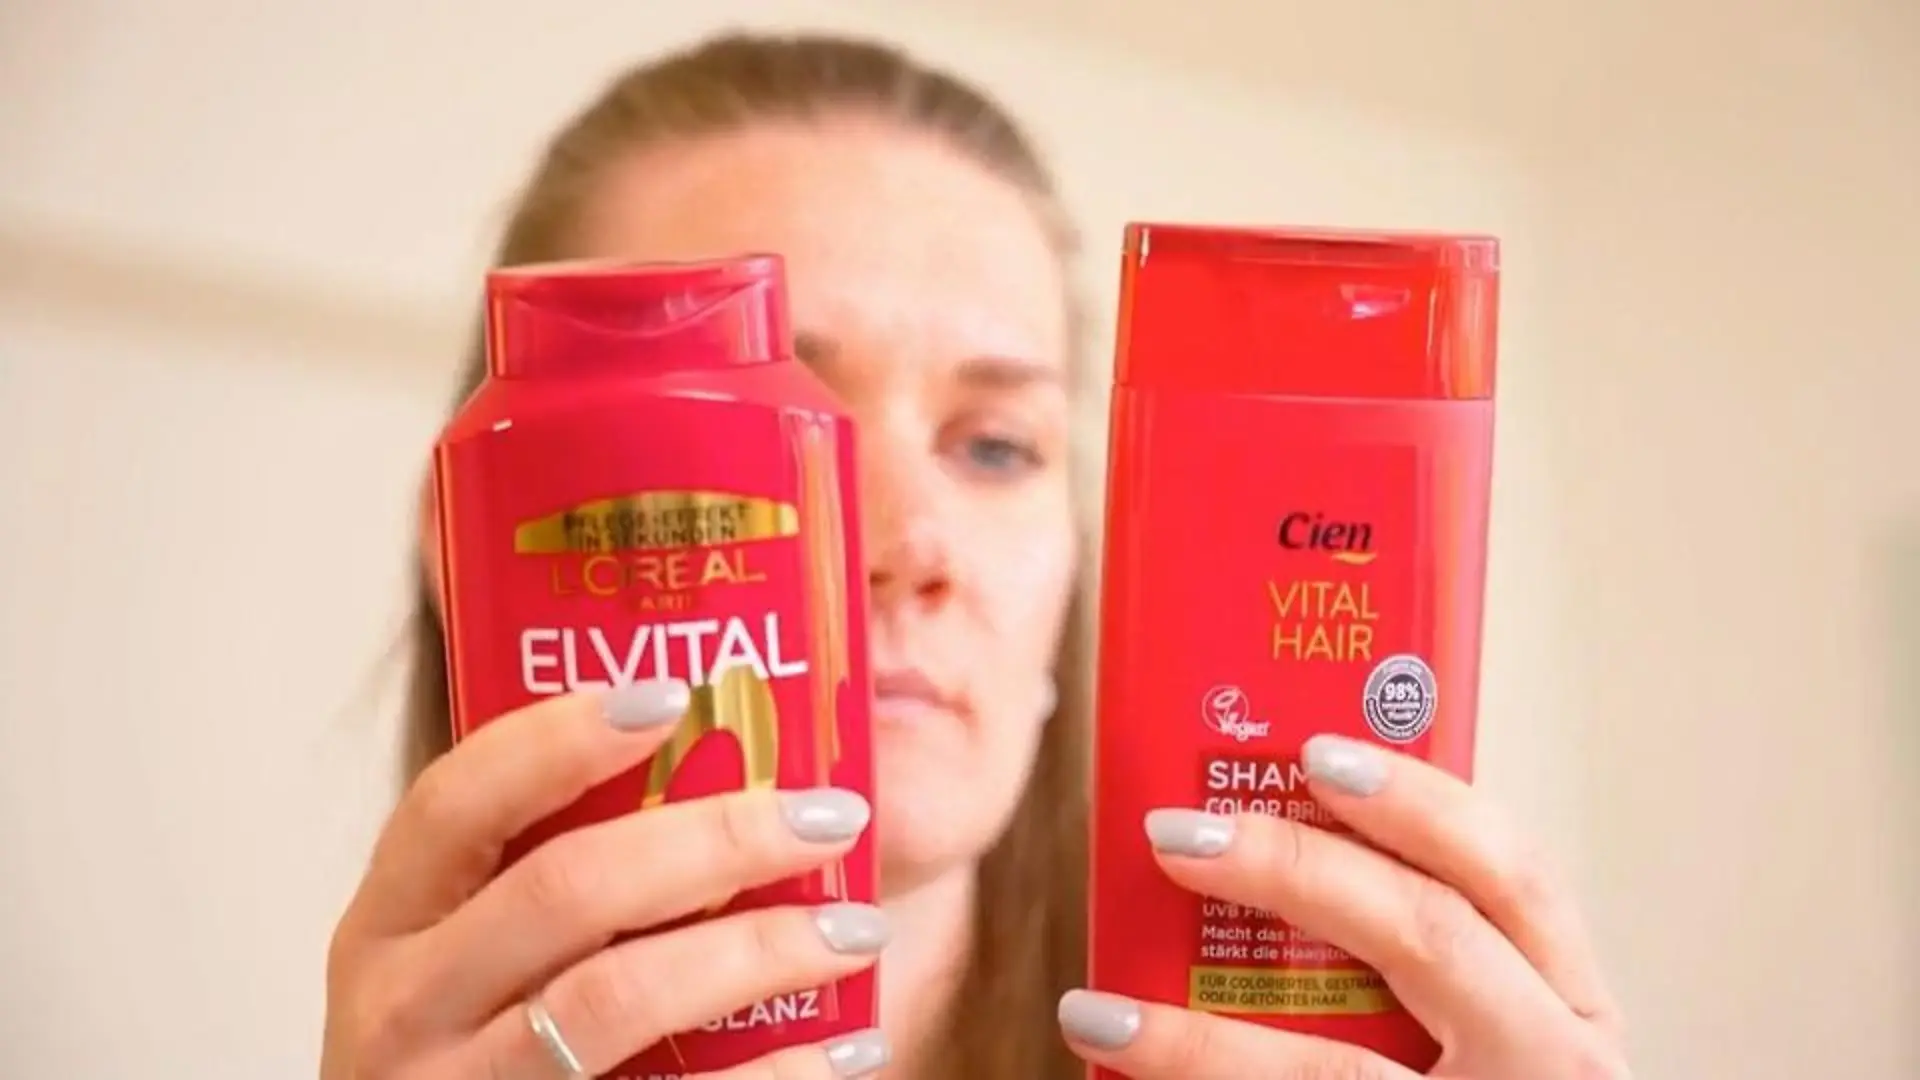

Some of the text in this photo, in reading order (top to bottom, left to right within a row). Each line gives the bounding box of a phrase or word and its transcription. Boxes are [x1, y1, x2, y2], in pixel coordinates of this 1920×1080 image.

[1278, 512, 1372, 553] Cien
[1268, 581, 1379, 620] VITAL
[520, 612, 808, 694] ELVITAL
[1273, 622, 1374, 662] HAIR
[1384, 681, 1421, 701] 98%
[1203, 903, 1239, 918] UVB
[1202, 924, 1253, 940] Macht
[1257, 927, 1286, 942] das
[1201, 943, 1249, 959] stärkt
[1253, 945, 1279, 961] die
